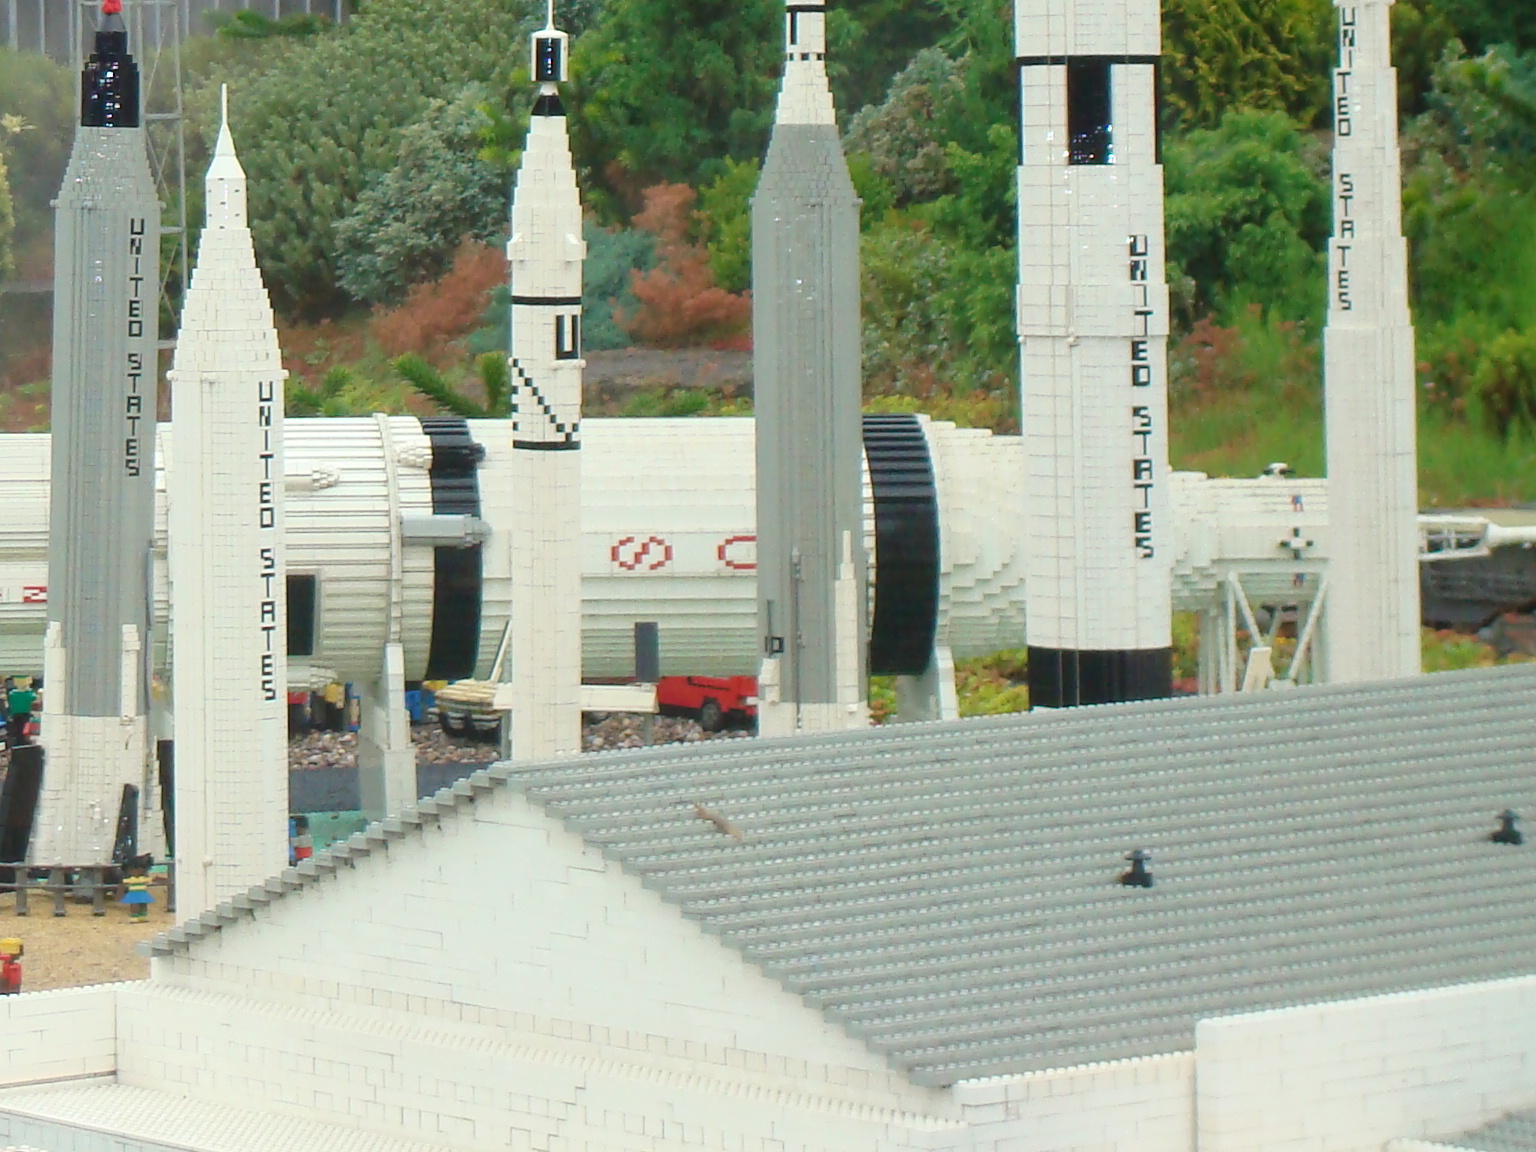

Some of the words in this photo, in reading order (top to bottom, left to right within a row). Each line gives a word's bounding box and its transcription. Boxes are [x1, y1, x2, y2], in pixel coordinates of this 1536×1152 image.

[1338, 6, 1355, 137] UNITED
[128, 218, 144, 338] UNITED
[1129, 235, 1153, 387] UNITED
[1337, 174, 1354, 311] STATES
[126, 353, 141, 476] STATES
[258, 381, 275, 528] UNITED
[1131, 406, 1155, 559] STATES
[260, 549, 275, 700] STATES
